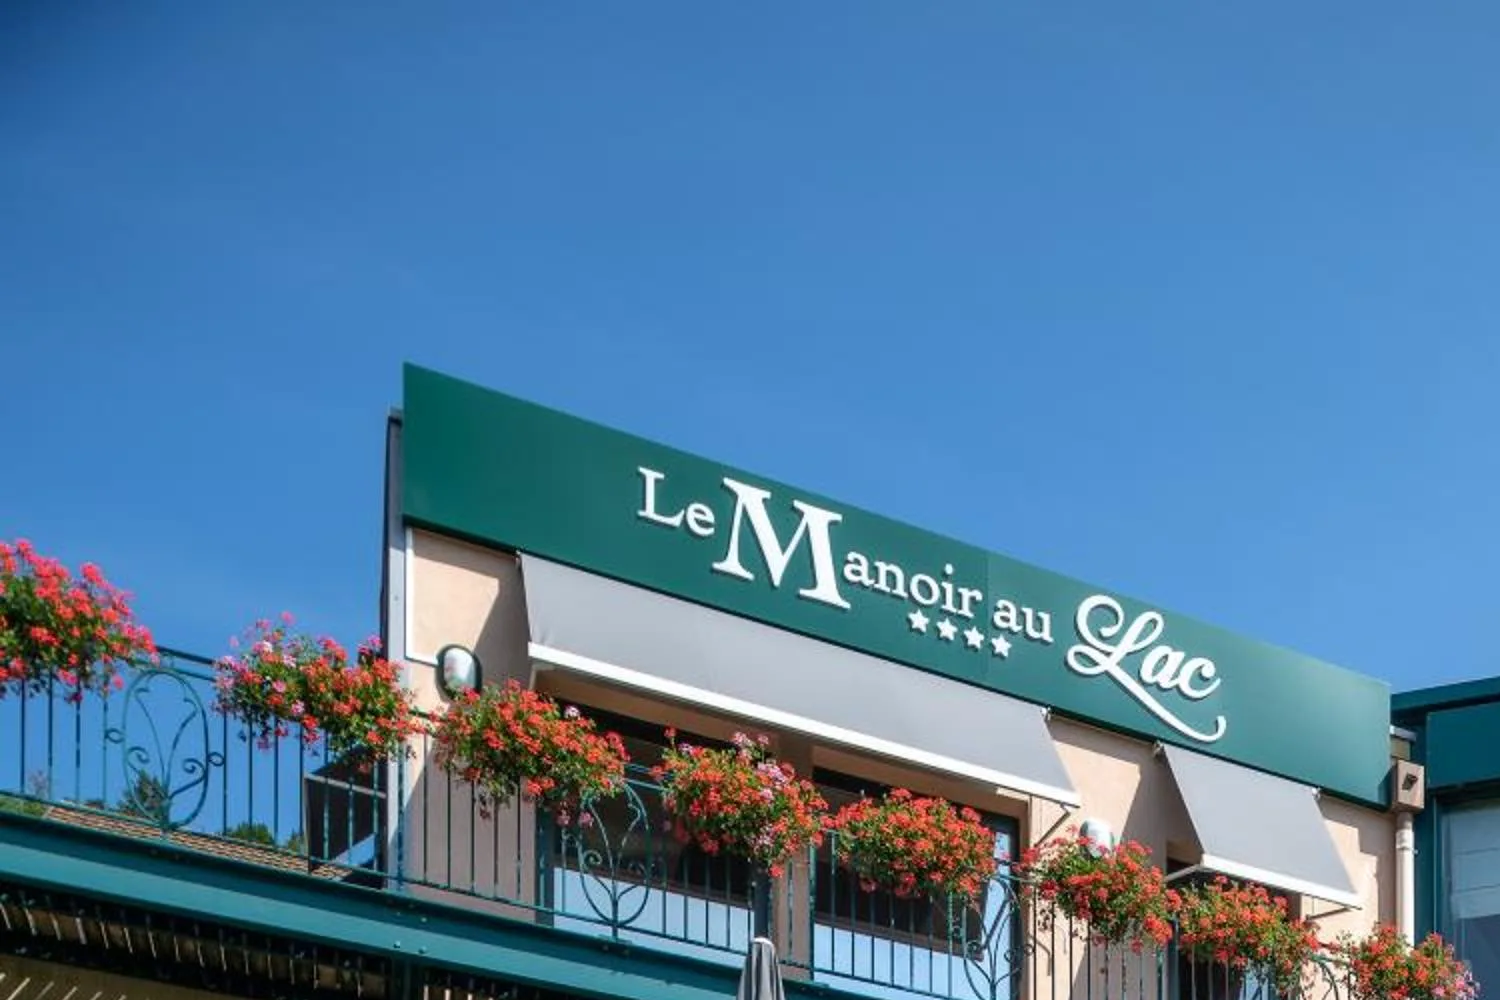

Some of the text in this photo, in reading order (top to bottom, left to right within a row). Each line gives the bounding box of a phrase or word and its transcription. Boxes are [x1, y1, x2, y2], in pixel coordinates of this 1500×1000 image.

[637, 467, 1226, 742] Le Manoir au Lac
